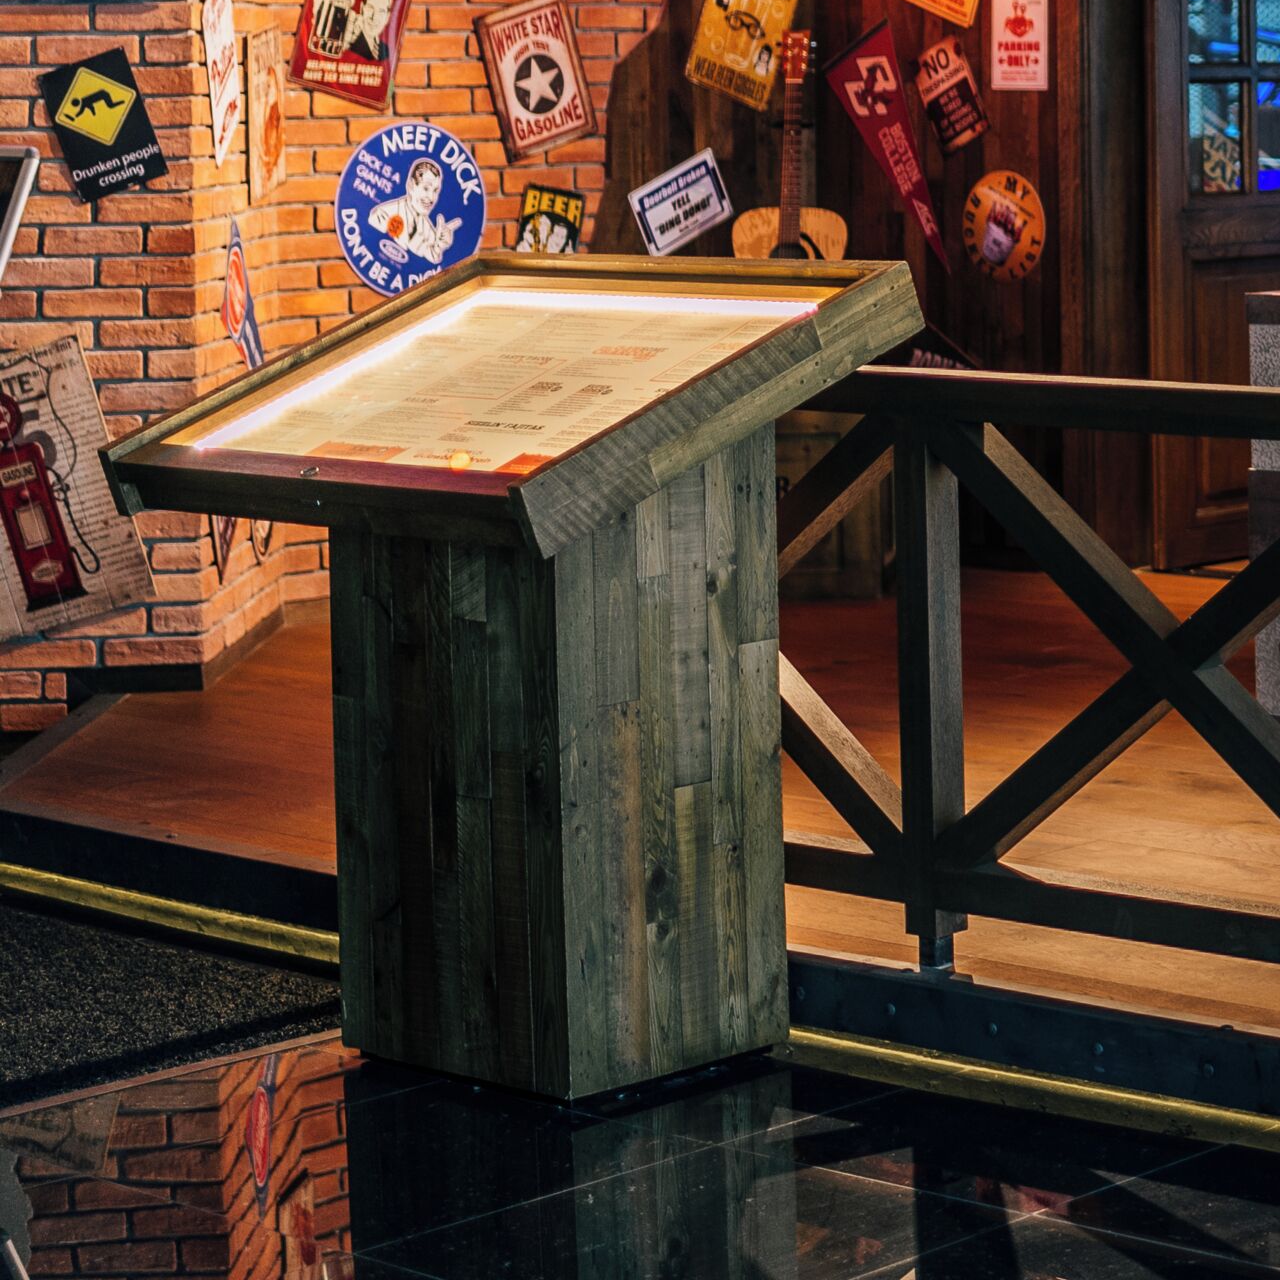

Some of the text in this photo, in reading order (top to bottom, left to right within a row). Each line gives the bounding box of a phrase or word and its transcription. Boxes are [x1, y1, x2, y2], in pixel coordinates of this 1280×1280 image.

[491, 9, 565, 63] WHITE STAR
[997, 42, 1041, 53] PARKING
[922, 48, 951, 80] NO
[1006, 55, 1031, 68] ONLY
[514, 94, 583, 142] GASOLINE
[72, 144, 160, 182] Drunken people
[358, 148, 384, 171] DICK
[381, 125, 482, 206] MEET DICK
[877, 126, 914, 197] COLLEGE
[889, 122, 923, 185] BOSTON
[98, 163, 145, 188] crossing
[1004, 175, 1031, 201] MY
[523, 187, 583, 229] BEER
[641, 183, 678, 209] Doorbell
[670, 191, 692, 211] YELL
[912, 198, 939, 236] ACC
[340, 207, 375, 269] DON'T
[367, 262, 391, 286] BE
[1008, 235, 1042, 280] LIST
[2, 462, 35, 484] GASOLINE
